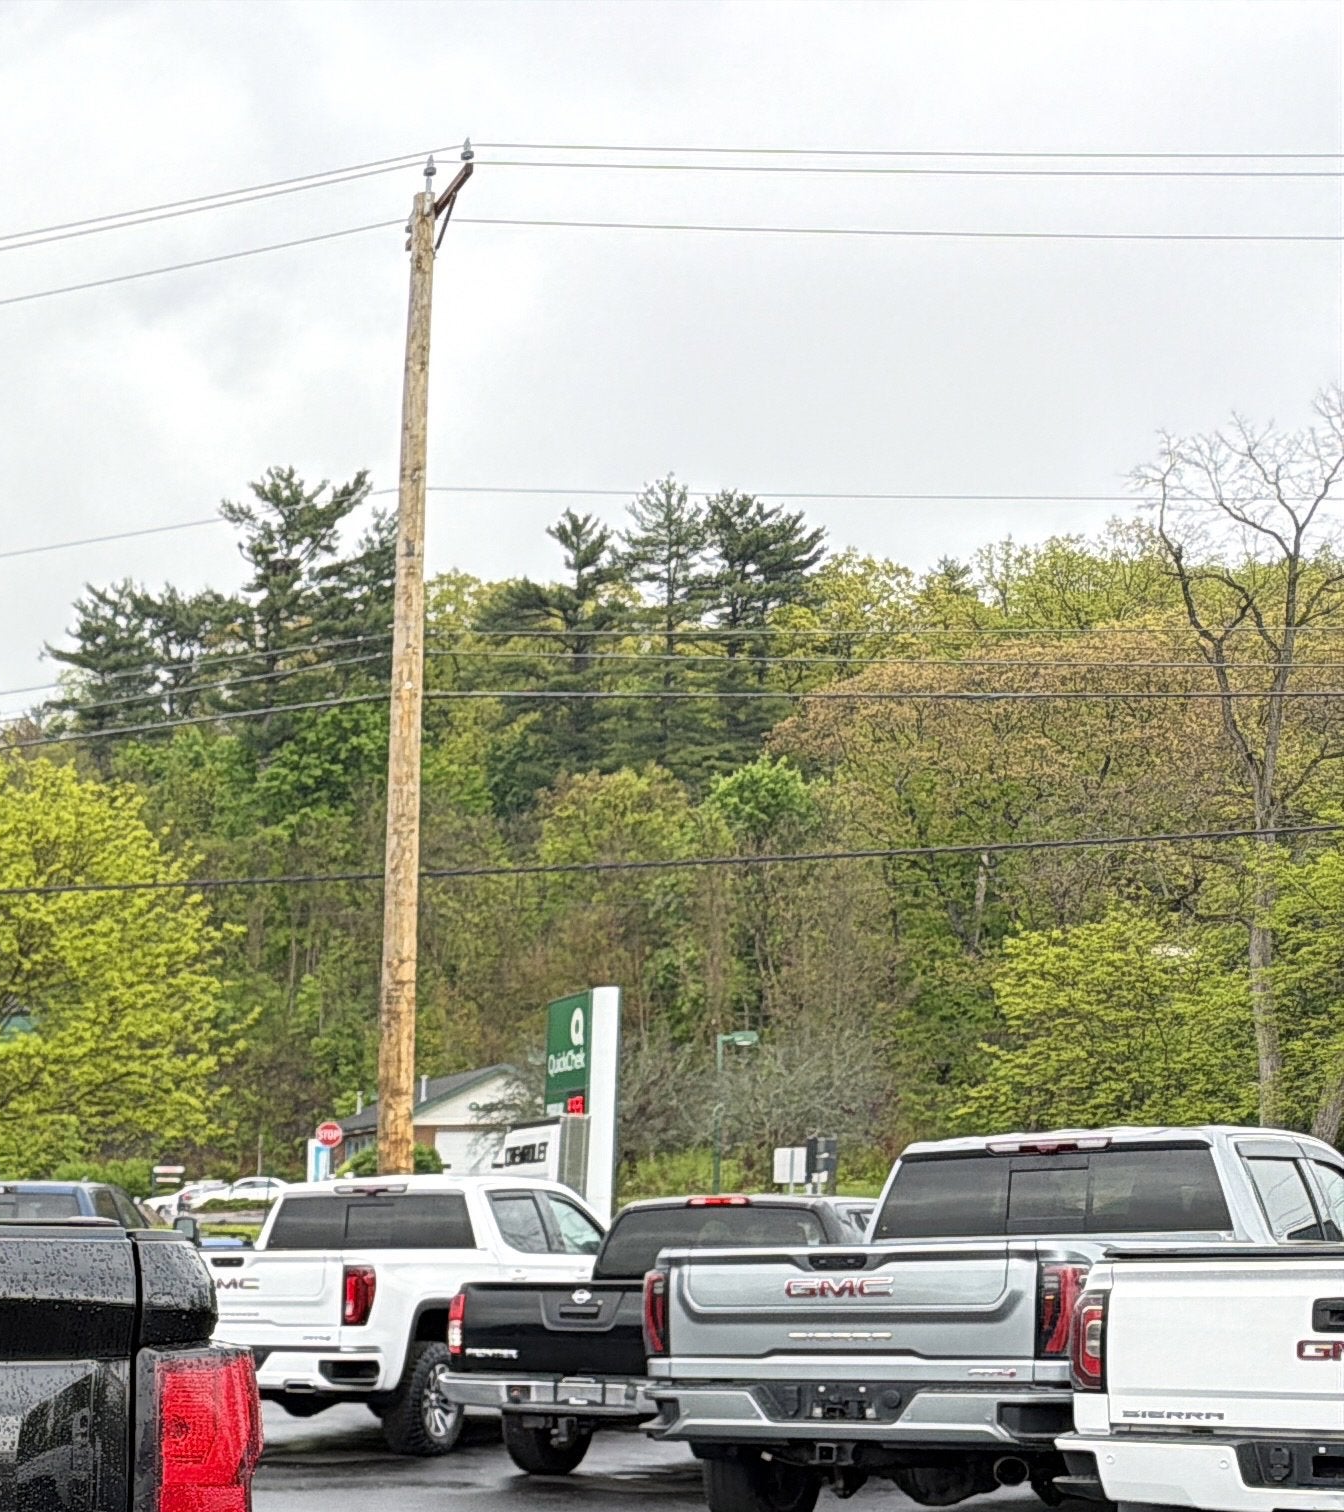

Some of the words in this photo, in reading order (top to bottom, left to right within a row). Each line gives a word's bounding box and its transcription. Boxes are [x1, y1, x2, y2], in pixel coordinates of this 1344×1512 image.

[317, 1128, 342, 1142] STOP
[213, 1277, 260, 1291] MC
[784, 1276, 895, 1299] GMC
[1121, 1409, 1226, 1421] SIERRA
